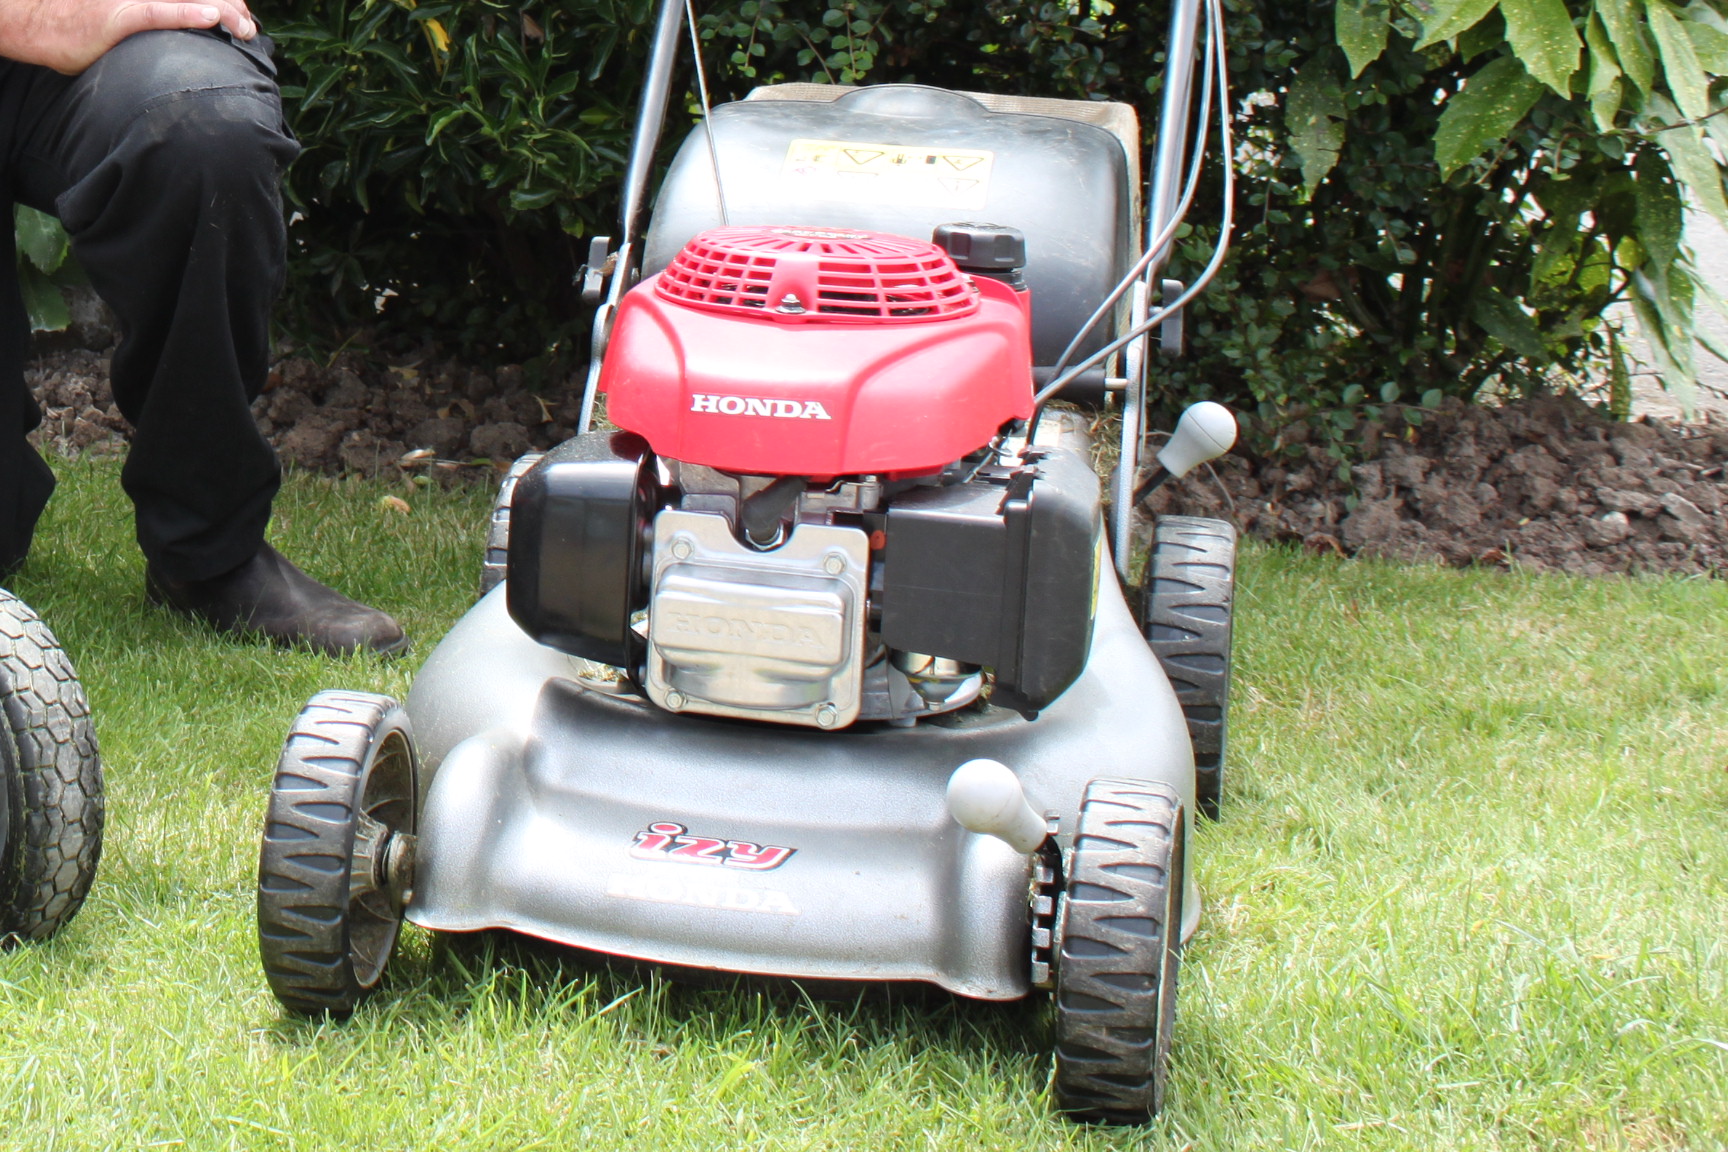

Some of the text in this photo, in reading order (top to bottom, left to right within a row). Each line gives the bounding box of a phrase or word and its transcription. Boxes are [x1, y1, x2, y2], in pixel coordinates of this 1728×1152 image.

[690, 393, 832, 421] HONDA
[668, 612, 827, 649] HONDA
[630, 821, 798, 871] izy
